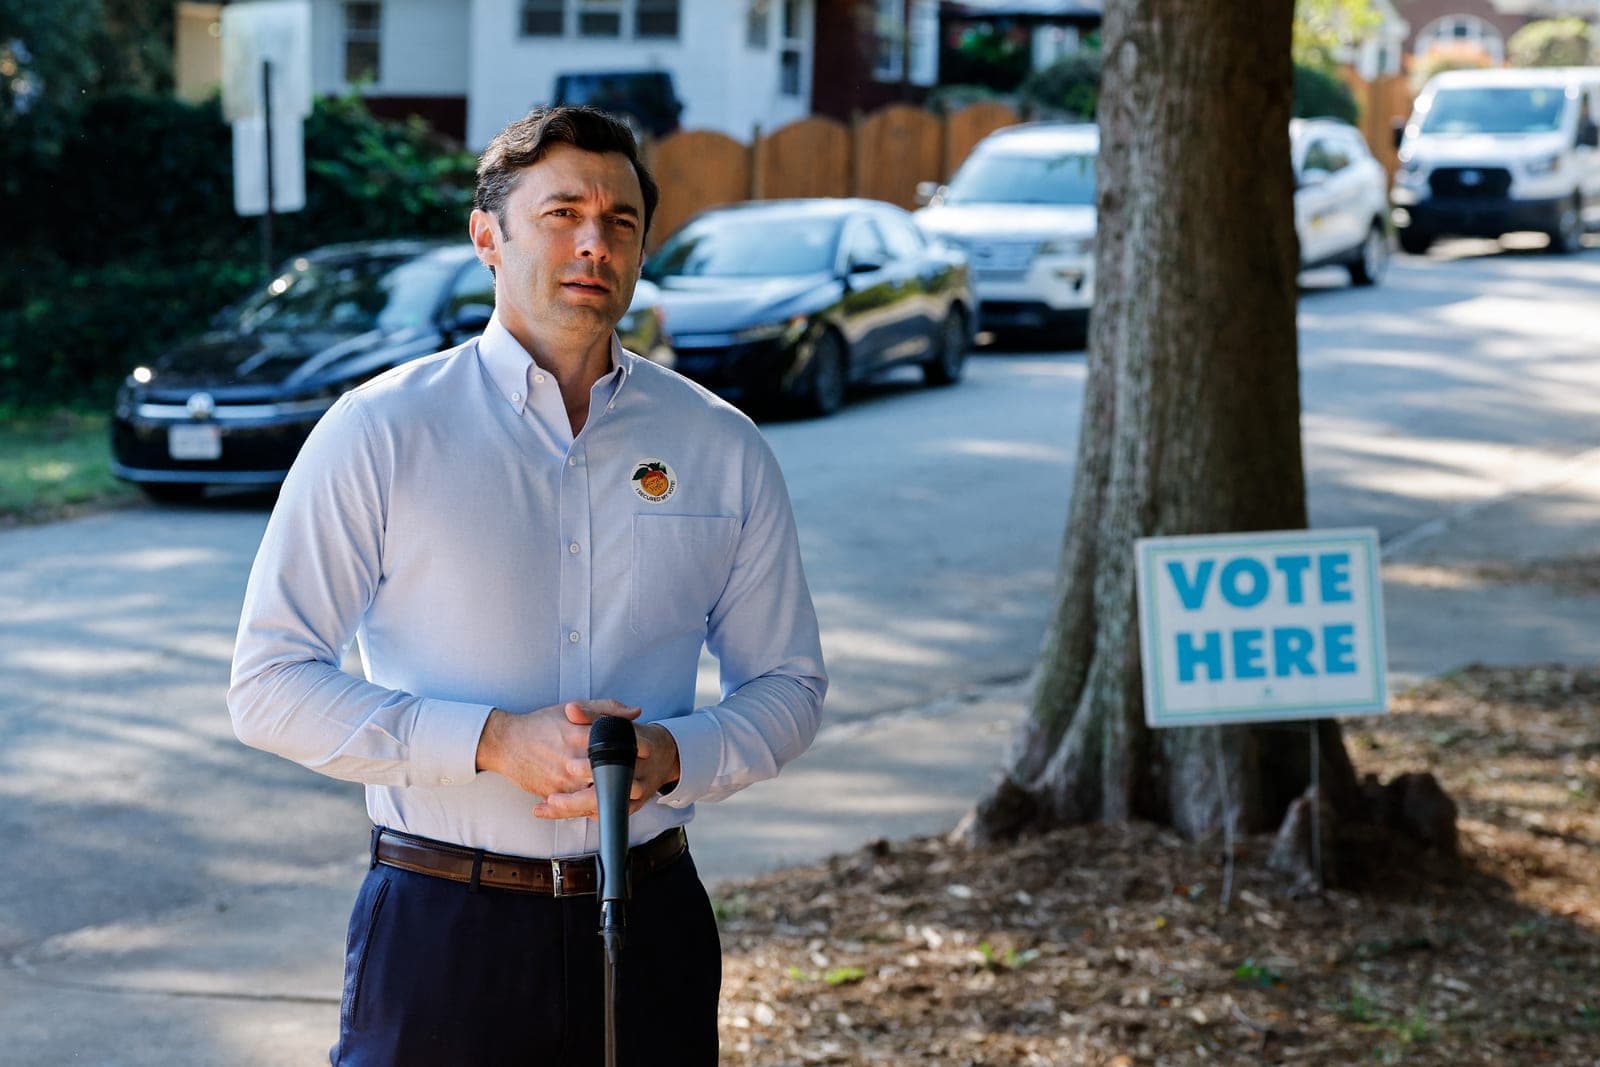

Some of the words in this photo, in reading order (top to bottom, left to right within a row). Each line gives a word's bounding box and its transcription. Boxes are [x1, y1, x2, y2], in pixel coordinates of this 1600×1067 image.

[637, 490, 661, 502] SECURED
[1166, 553, 1352, 611] VOTE
[1176, 624, 1356, 682] HERE
